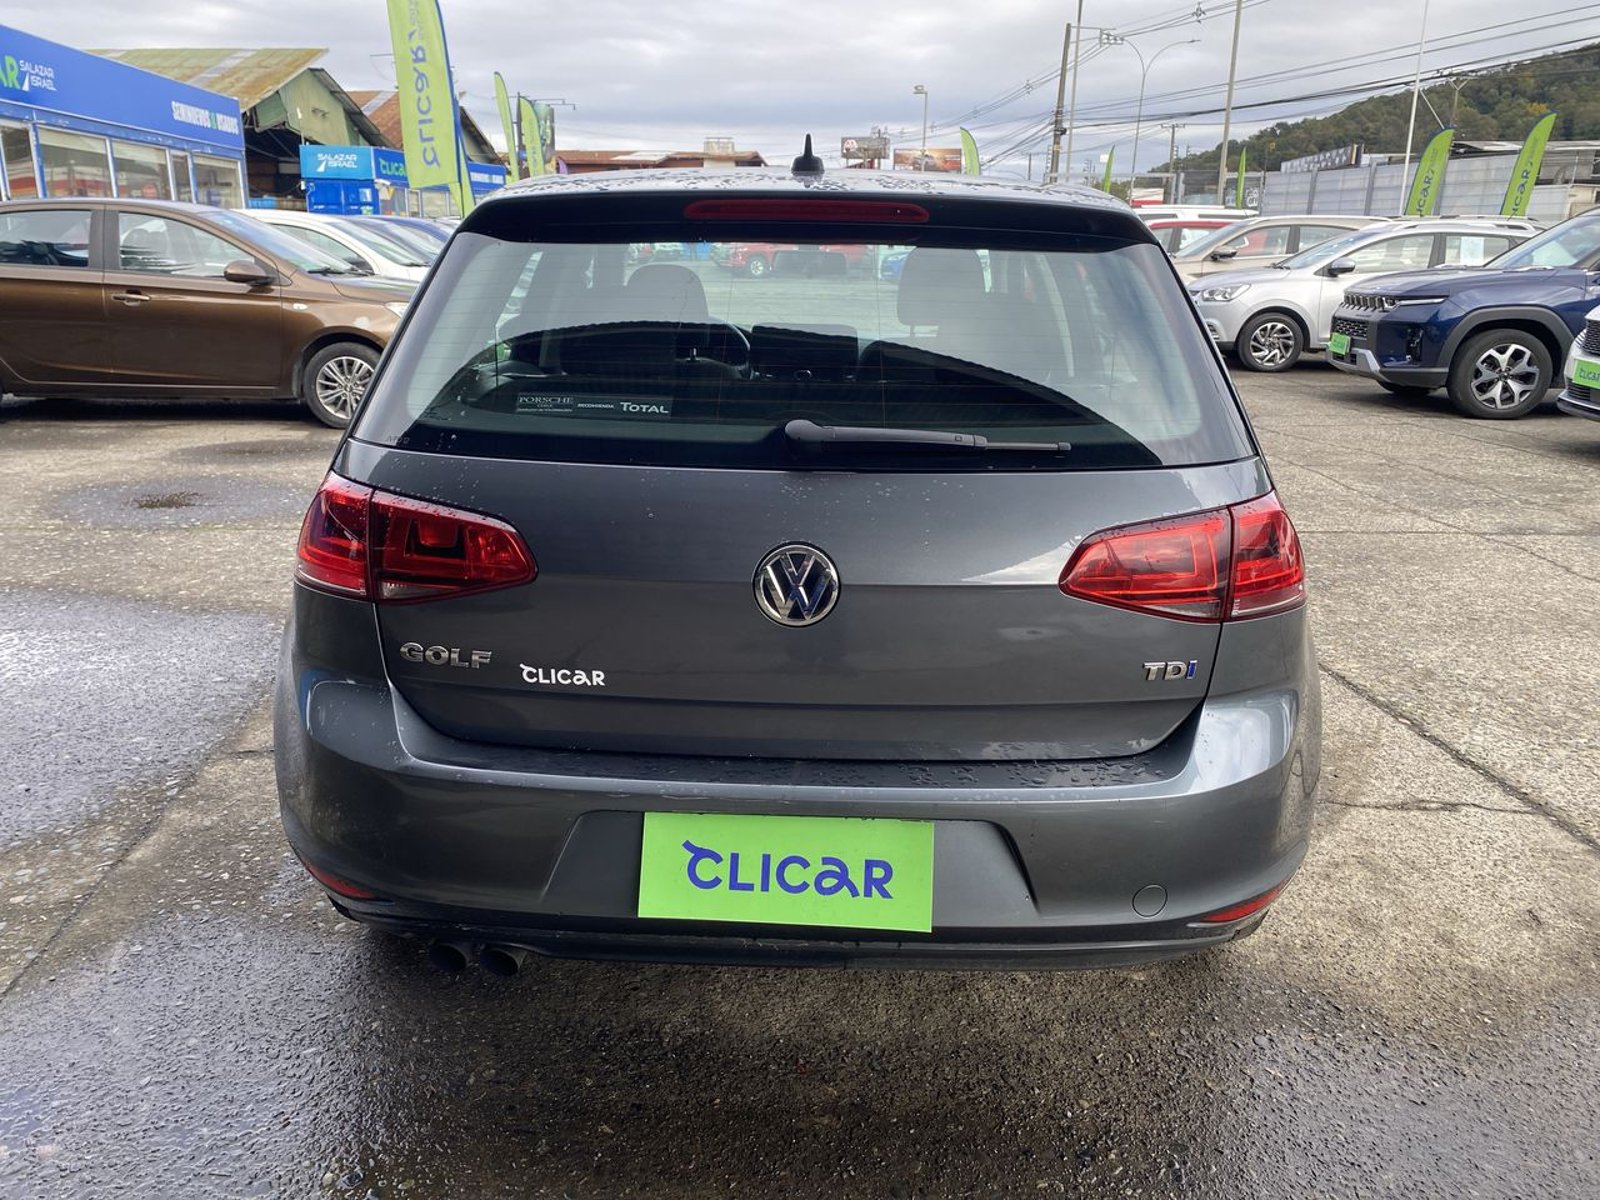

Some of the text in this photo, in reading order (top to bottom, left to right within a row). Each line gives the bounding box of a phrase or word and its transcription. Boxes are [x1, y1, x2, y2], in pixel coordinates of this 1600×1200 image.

[19, 59, 55, 79] SALAZAR
[30, 75, 57, 91] ISRAEL
[317, 153, 358, 161] SALAZAR
[327, 160, 358, 168] ISRAEL
[379, 158, 406, 177] CLICA
[519, 396, 573, 404] PORSCHE
[620, 401, 669, 414] TOTAL
[400, 641, 492, 669] GOLF
[519, 663, 605, 686] CLICAR
[1143, 659, 1198, 680] TDI
[681, 839, 893, 899] CLICAR
